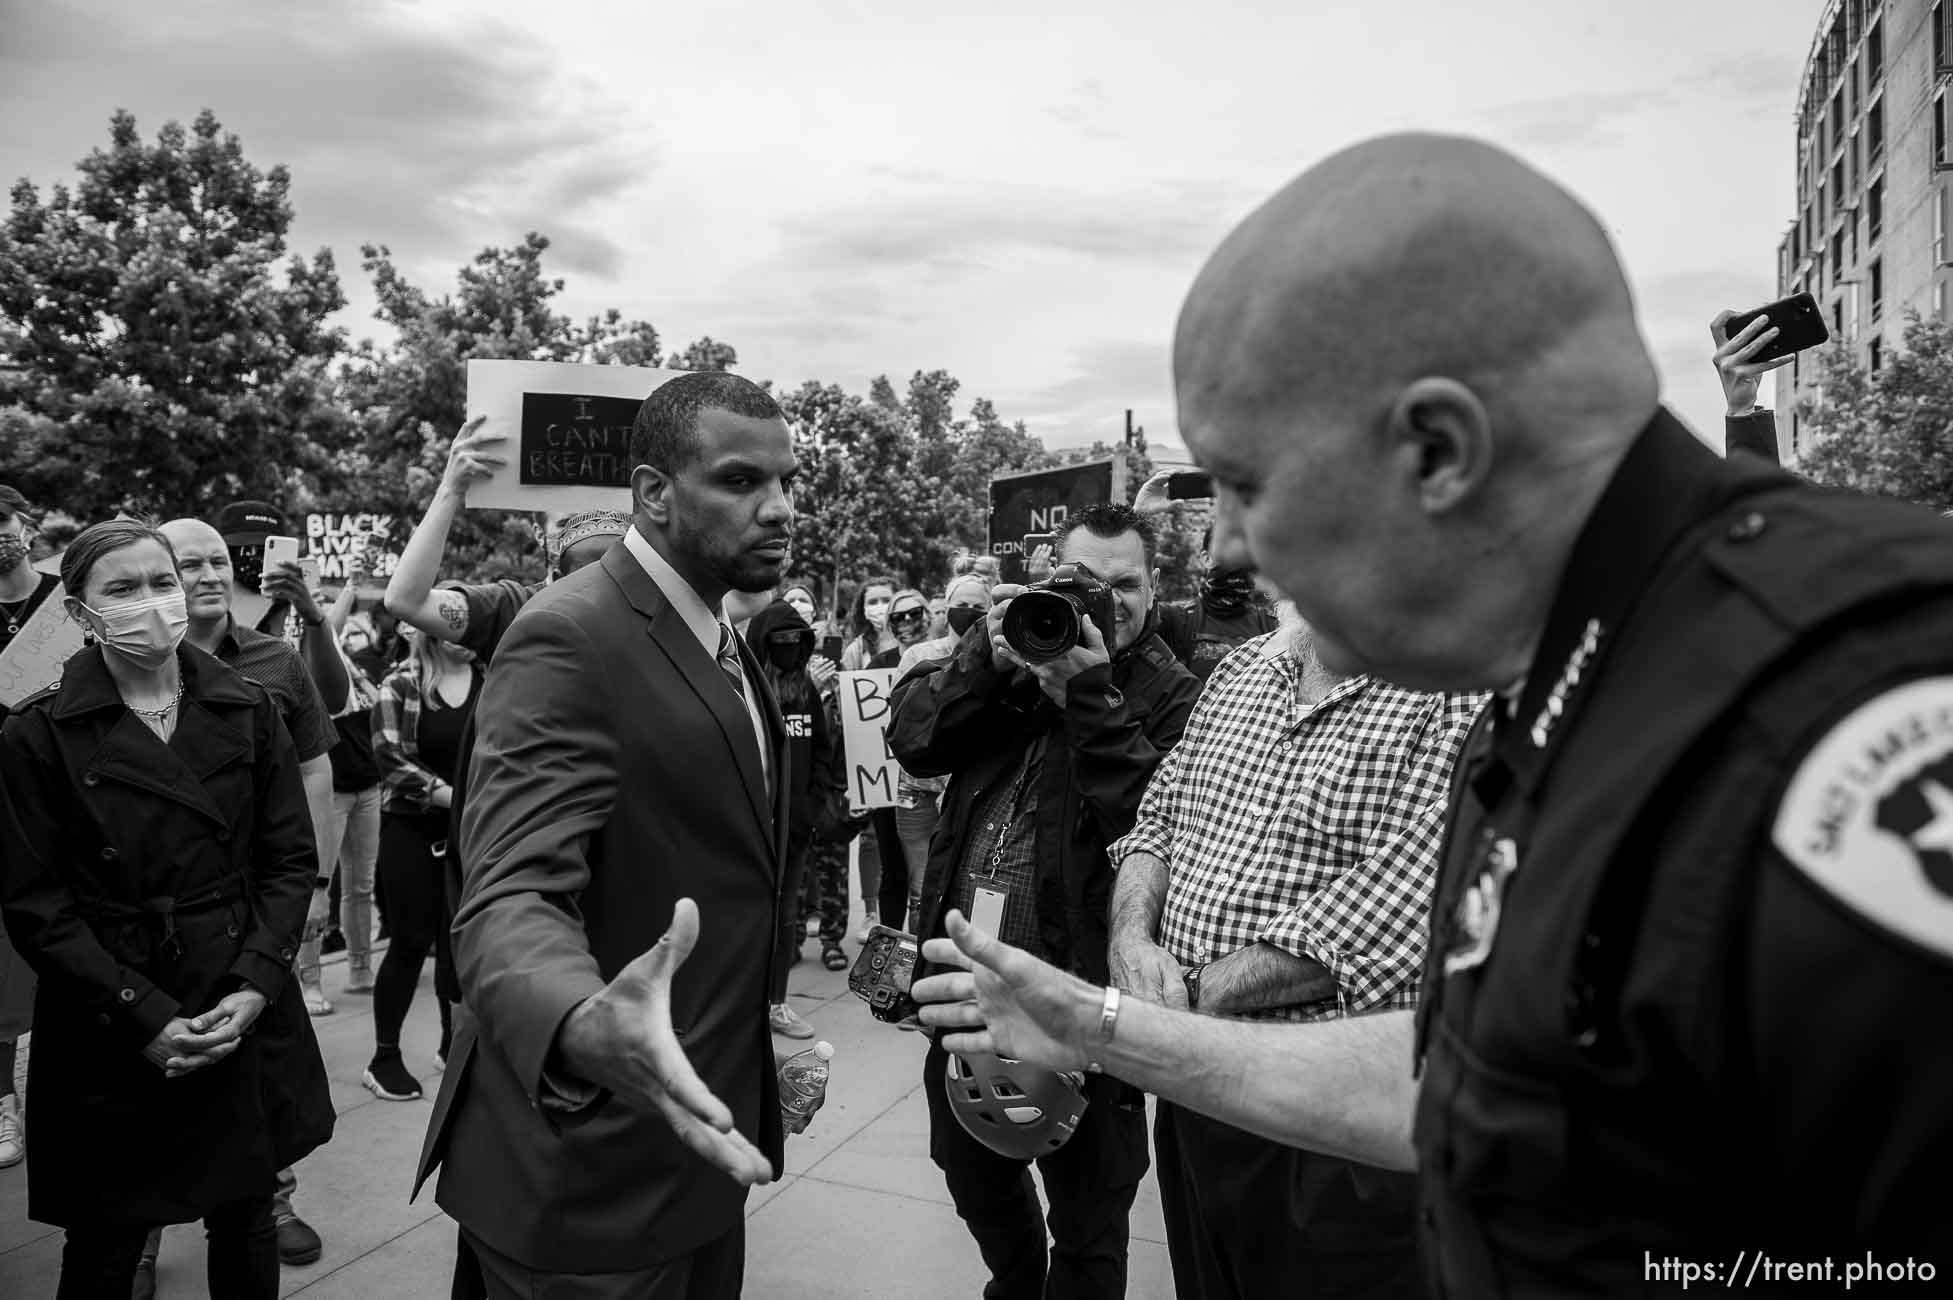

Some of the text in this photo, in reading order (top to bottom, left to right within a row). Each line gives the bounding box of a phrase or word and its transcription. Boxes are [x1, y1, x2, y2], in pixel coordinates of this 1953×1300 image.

[574, 396, 595, 421] I
[529, 449, 634, 480] BREATH
[306, 513, 393, 537] BLACK
[1031, 505, 1067, 532] NO
[308, 535, 372, 555] LIVE
[856, 764, 892, 805] M
